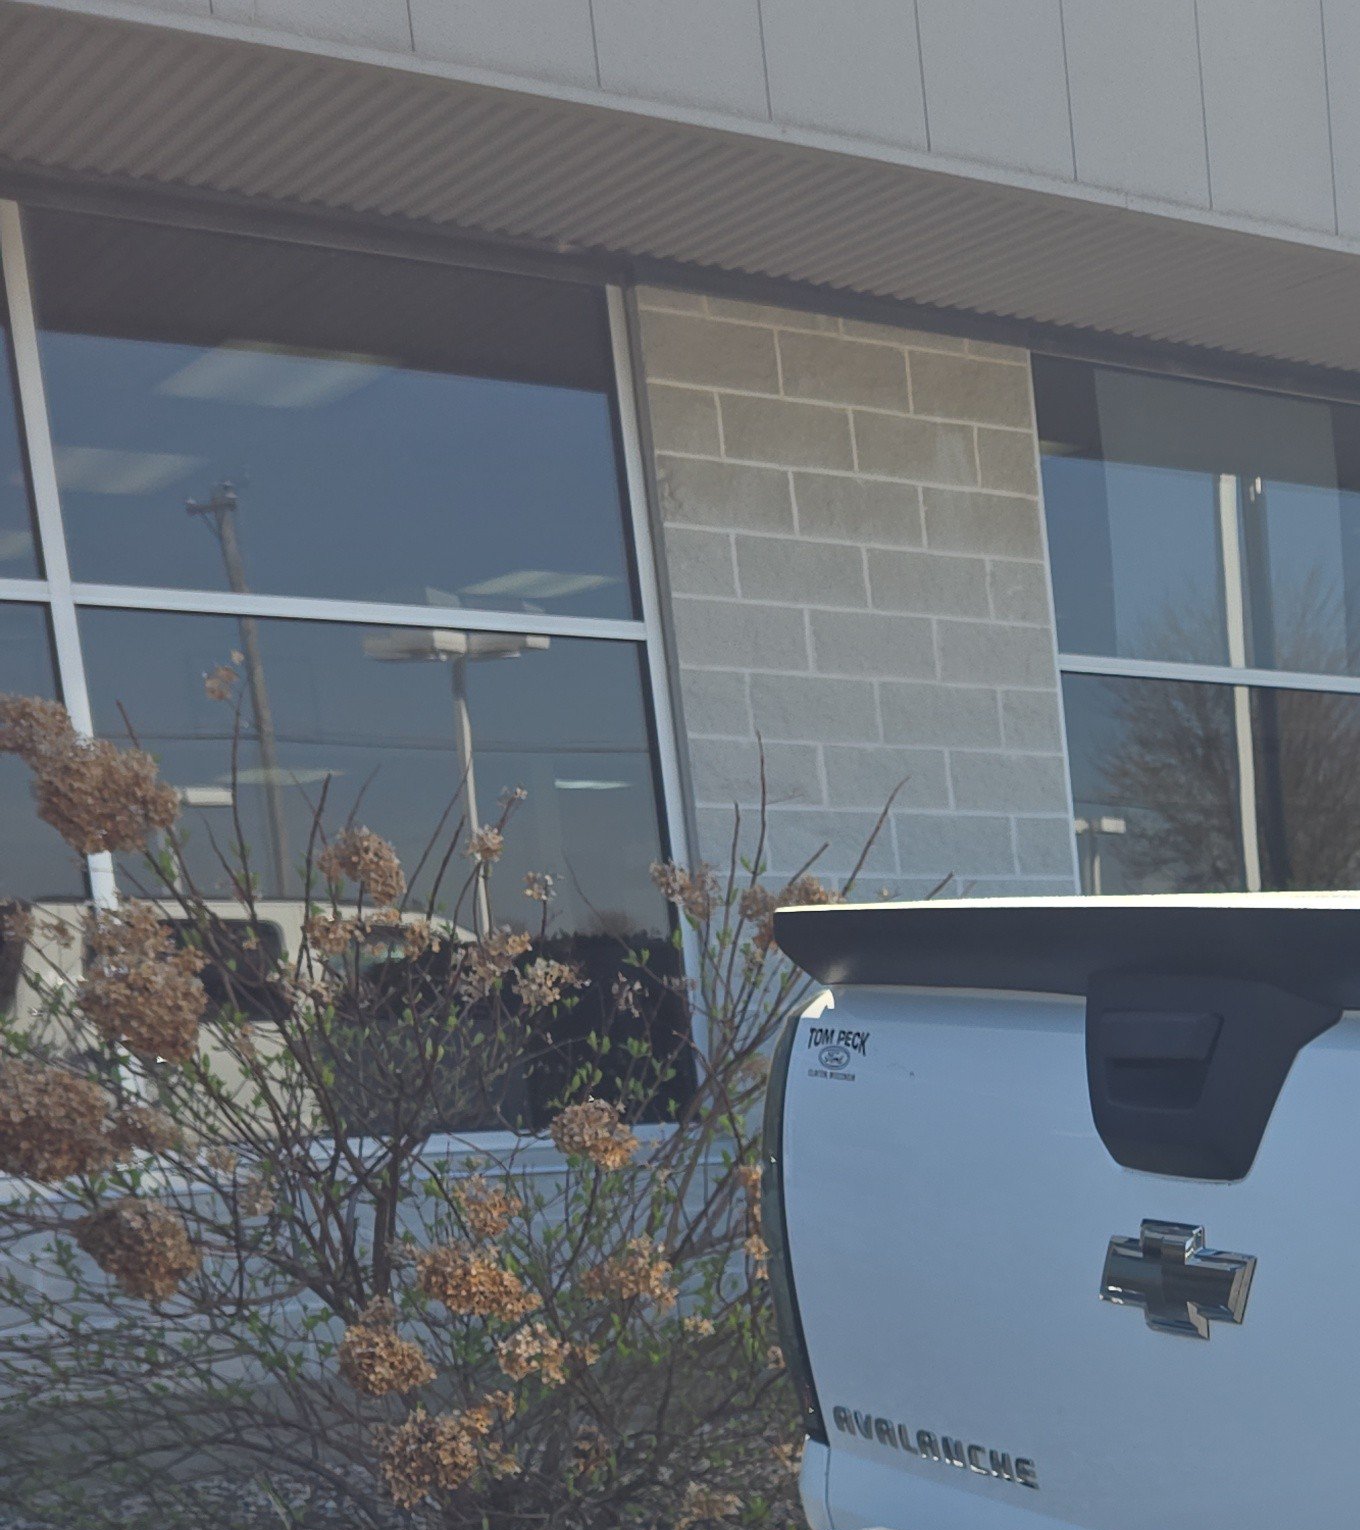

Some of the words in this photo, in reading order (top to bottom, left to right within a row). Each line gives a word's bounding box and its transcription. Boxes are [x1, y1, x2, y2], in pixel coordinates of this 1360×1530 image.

[808, 1026, 835, 1049] TOM
[836, 1029, 870, 1057] PECK
[833, 1405, 1040, 1490] AVALANCHE
